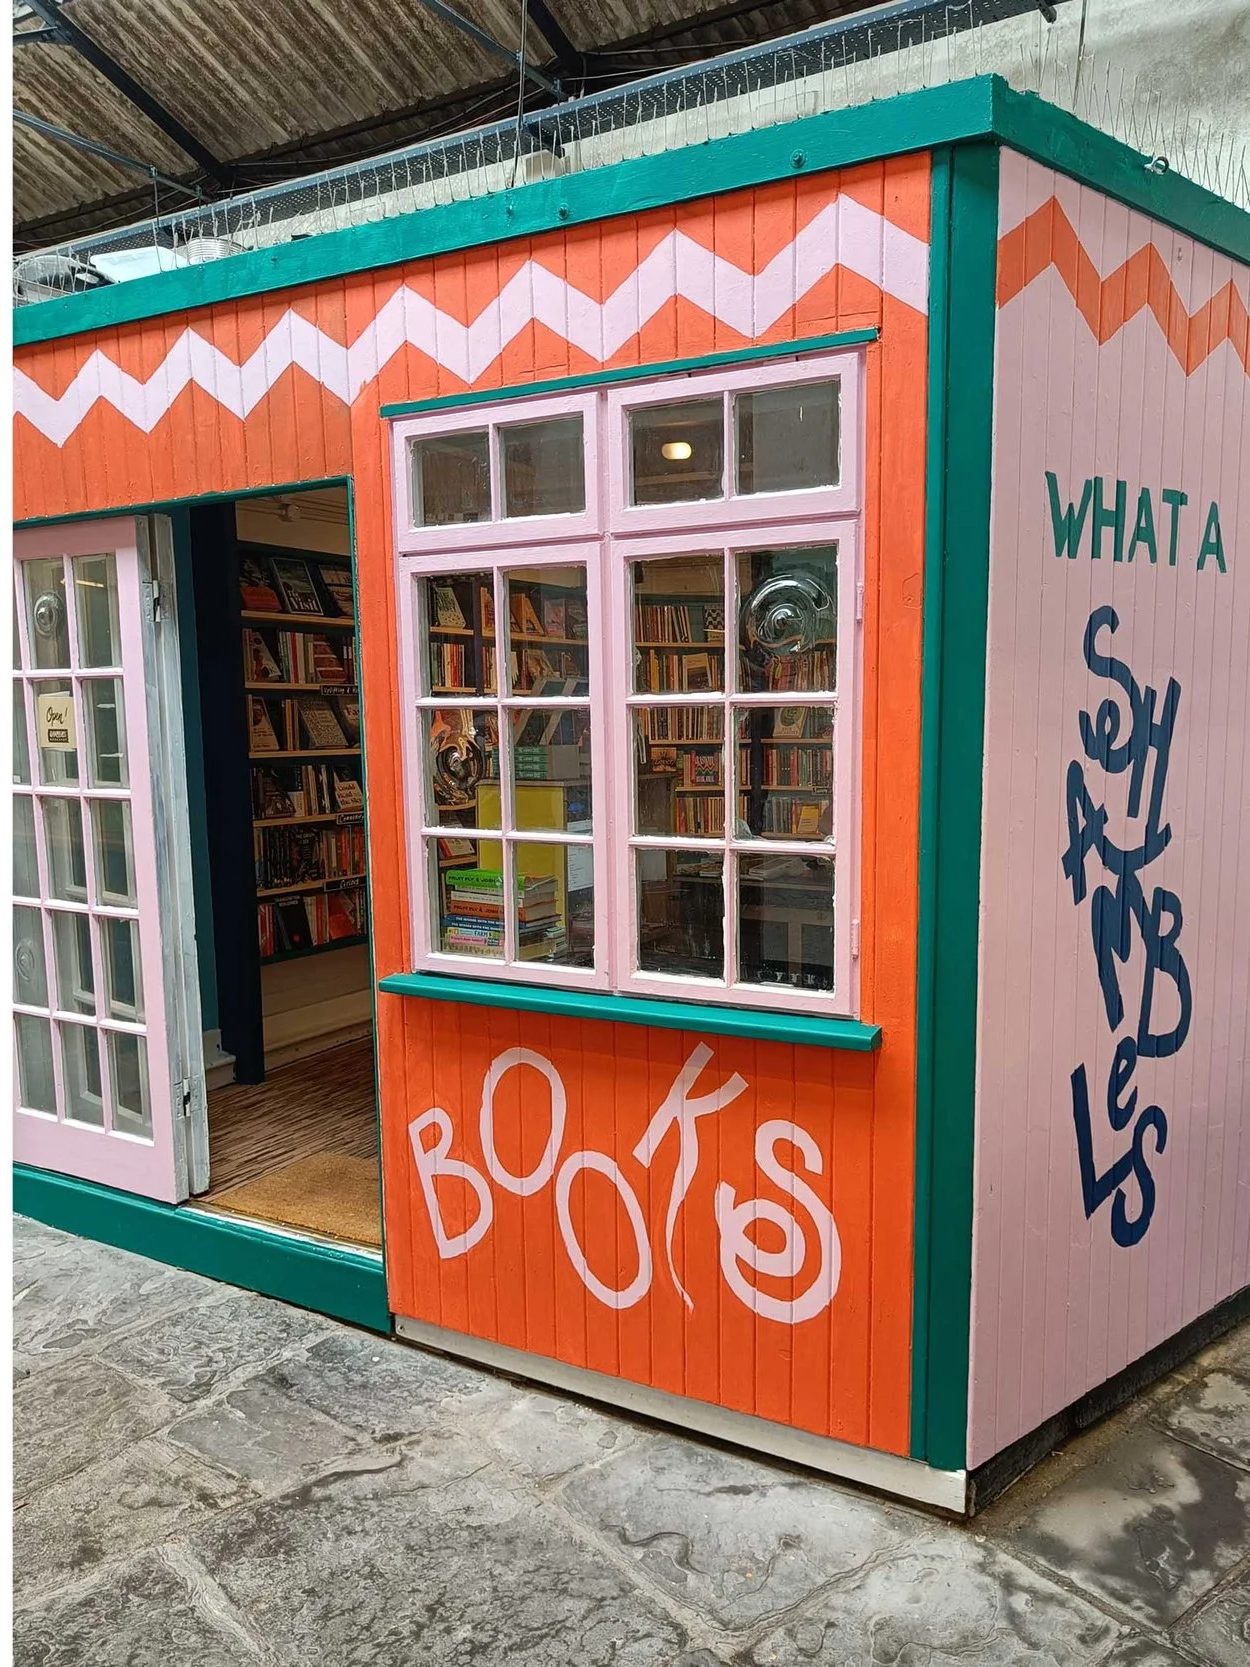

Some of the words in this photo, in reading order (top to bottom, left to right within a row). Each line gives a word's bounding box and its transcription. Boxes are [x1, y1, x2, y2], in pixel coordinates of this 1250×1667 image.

[1045, 469, 1188, 568] WHAT
[1196, 500, 1227, 573] A
[289, 597, 319, 612] Visit
[408, 1041, 842, 1324] BOOKS
